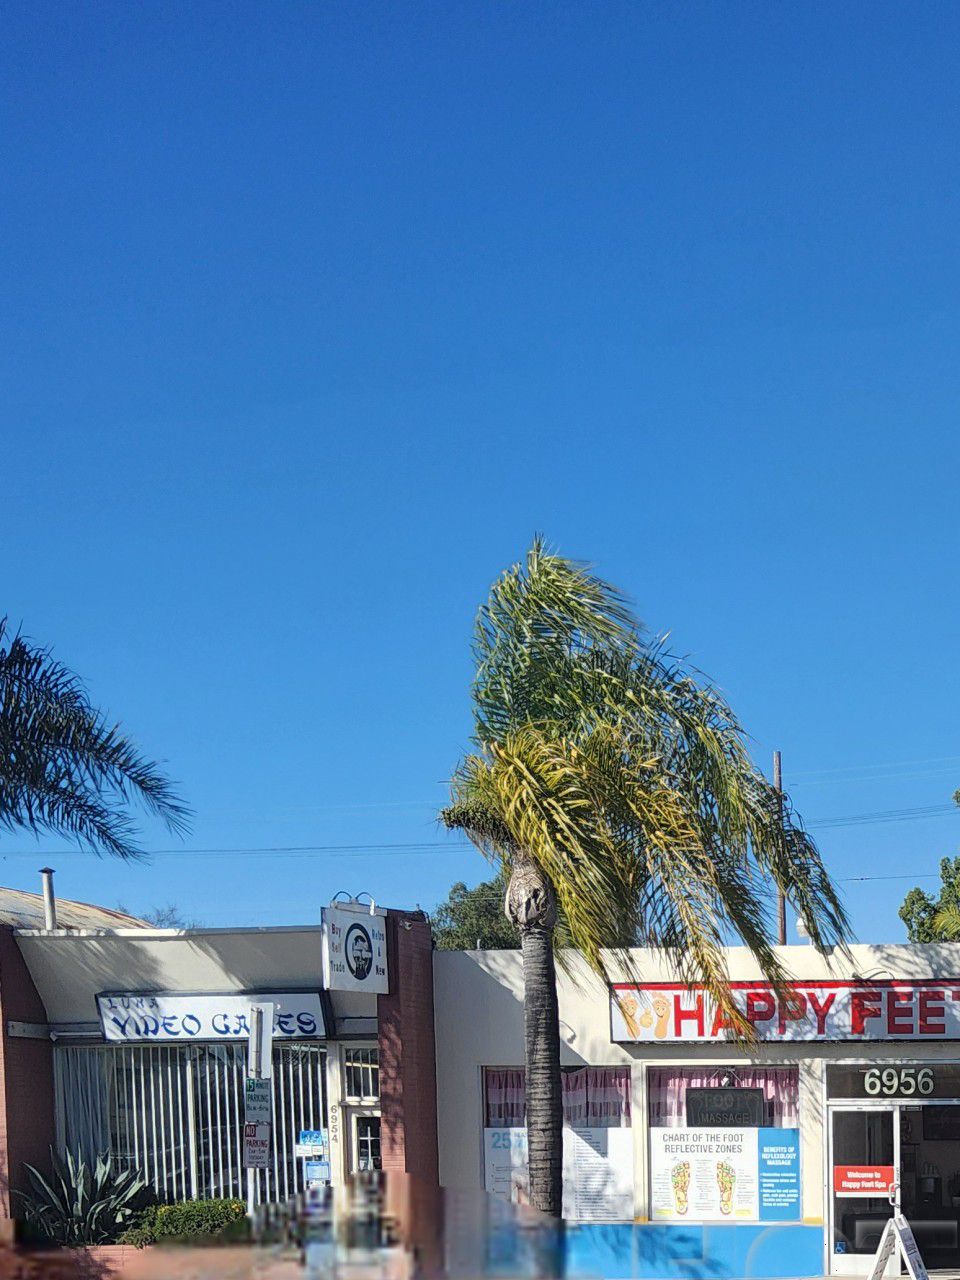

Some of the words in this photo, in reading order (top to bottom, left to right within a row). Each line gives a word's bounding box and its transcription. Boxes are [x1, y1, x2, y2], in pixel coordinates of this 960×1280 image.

[331, 923, 341, 937] Buy
[330, 960, 346, 973] Trade
[375, 964, 386, 976] New
[673, 992, 837, 1037] HAPPY
[111, 1013, 202, 1037] VIDEO
[211, 1011, 318, 1036] GAES
[247, 1080, 254, 1092] 15
[863, 1067, 936, 1096] 6956
[247, 1093, 269, 1103] PARKING
[330, 1104, 339, 1144] 6954
[701, 1112, 750, 1125] MASSAGE
[246, 1126, 255, 1135] NO
[662, 1133, 690, 1143] CHART
[692, 1133, 703, 1143] OF
[705, 1133, 721, 1143] THE
[723, 1133, 744, 1143] FOOT
[246, 1140, 268, 1149] PARKING
[664, 1144, 715, 1154] REFLECTIVE
[715, 1144, 743, 1154] ZONES
[847, 1171, 874, 1179] Welcome
[874, 1171, 882, 1179] to
[841, 1180, 861, 1189] Happy
[874, 1180, 887, 1189] Spa
